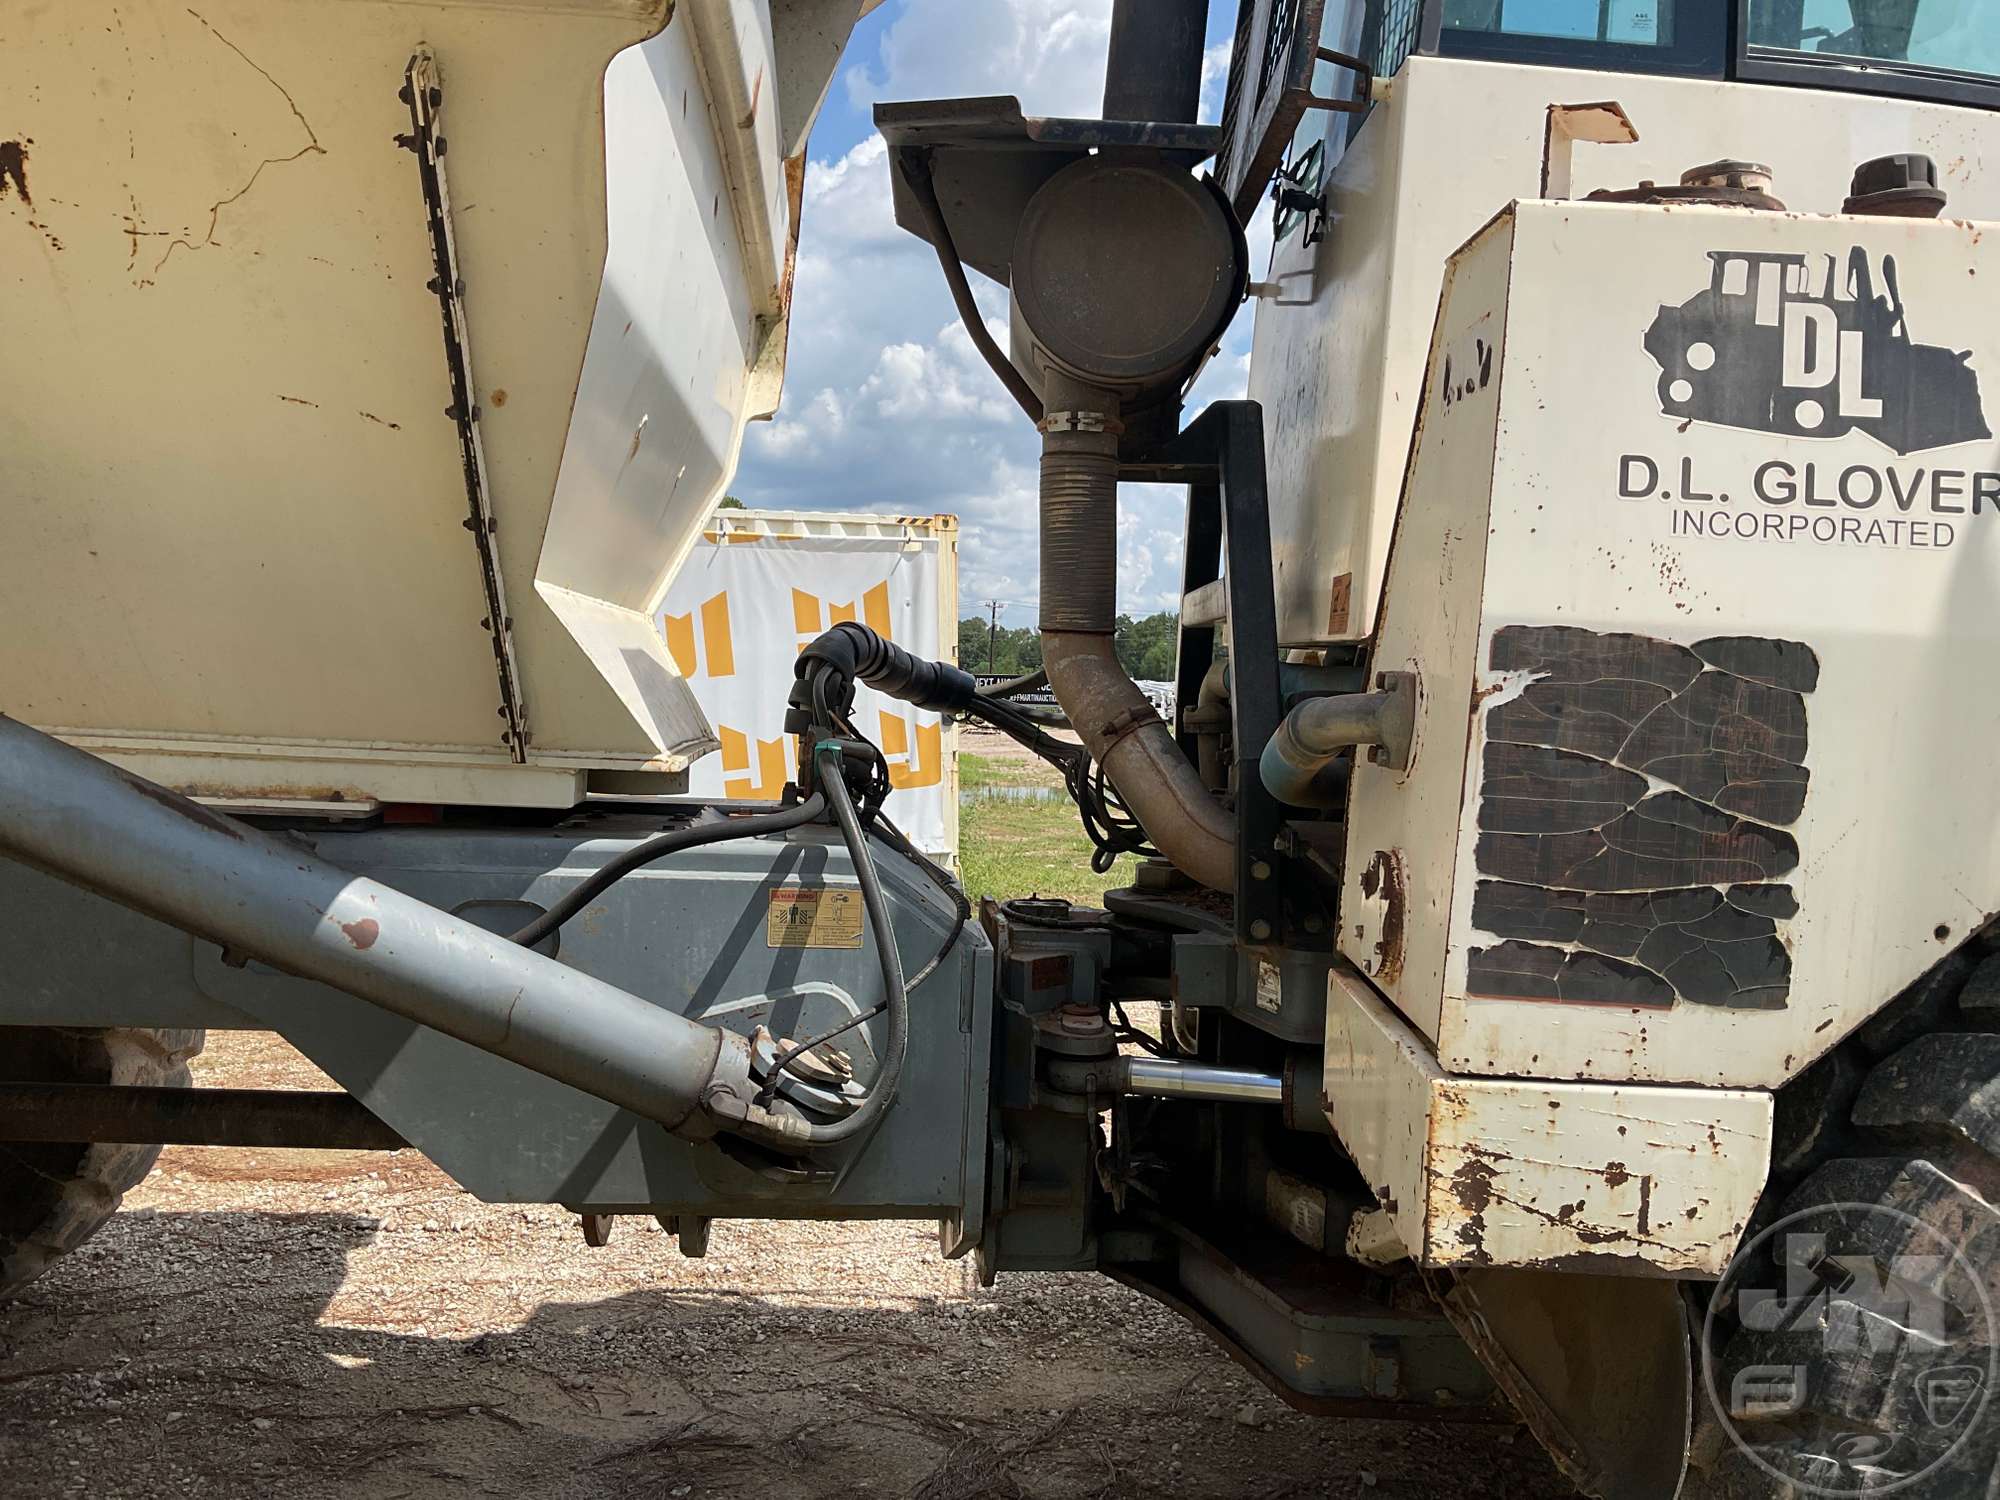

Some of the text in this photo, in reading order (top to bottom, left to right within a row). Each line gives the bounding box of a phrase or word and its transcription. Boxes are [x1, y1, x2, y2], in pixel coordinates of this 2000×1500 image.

[1618, 454, 2000, 515] D.L. GLOVER
[1671, 508, 1955, 548] INCORPORATED
